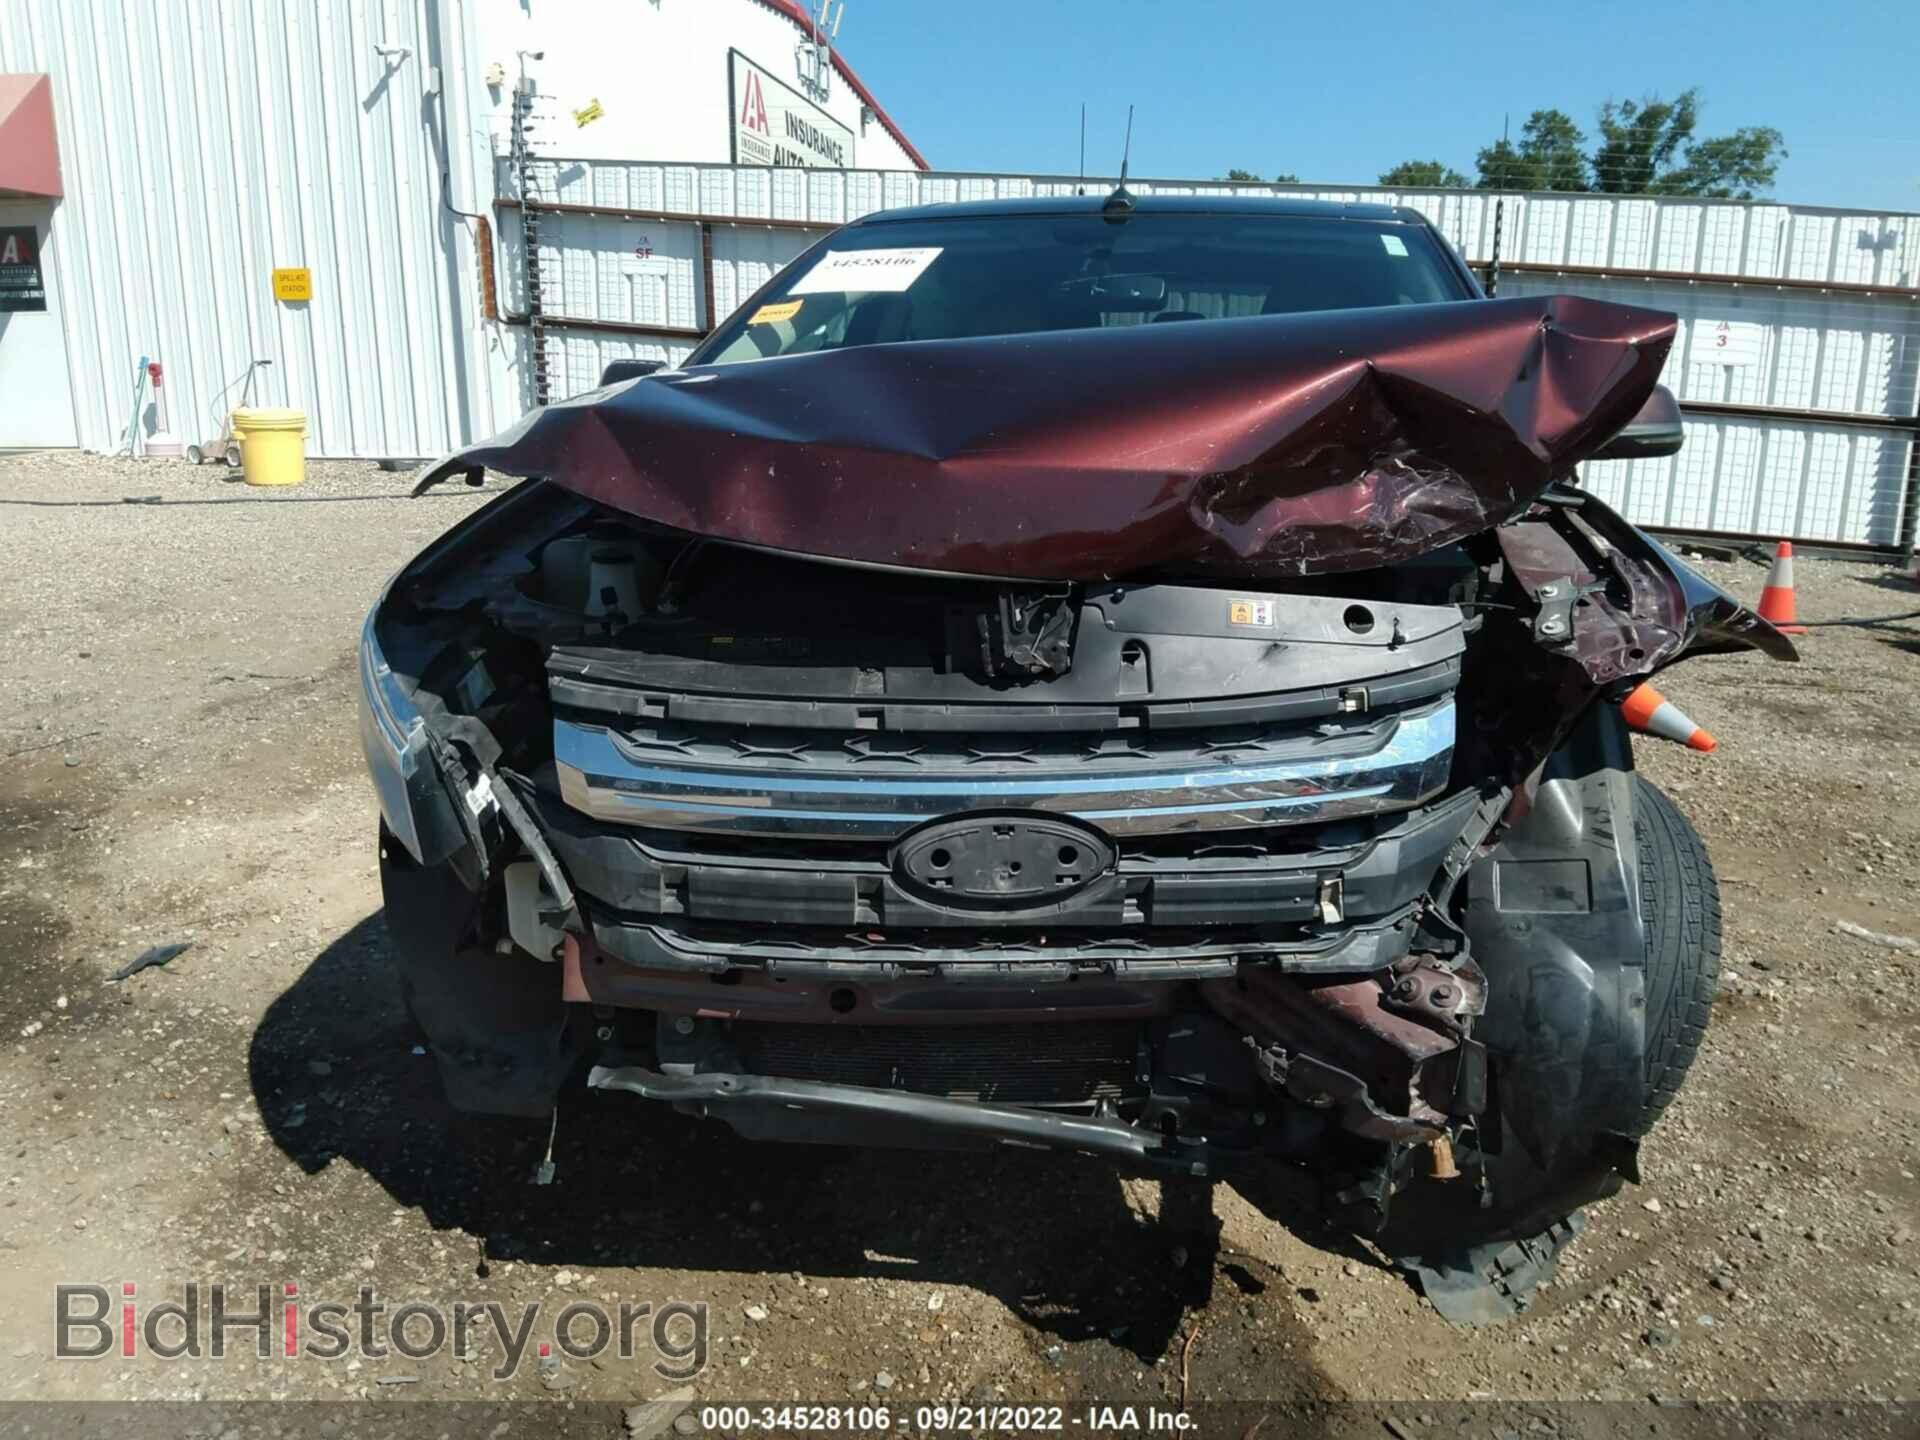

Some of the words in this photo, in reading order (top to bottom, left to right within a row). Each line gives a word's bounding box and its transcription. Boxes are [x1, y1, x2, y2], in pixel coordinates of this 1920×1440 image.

[785, 110, 843, 168] INSURANCE
[635, 248, 653, 259] SF
[1716, 334, 1727, 347] 3
